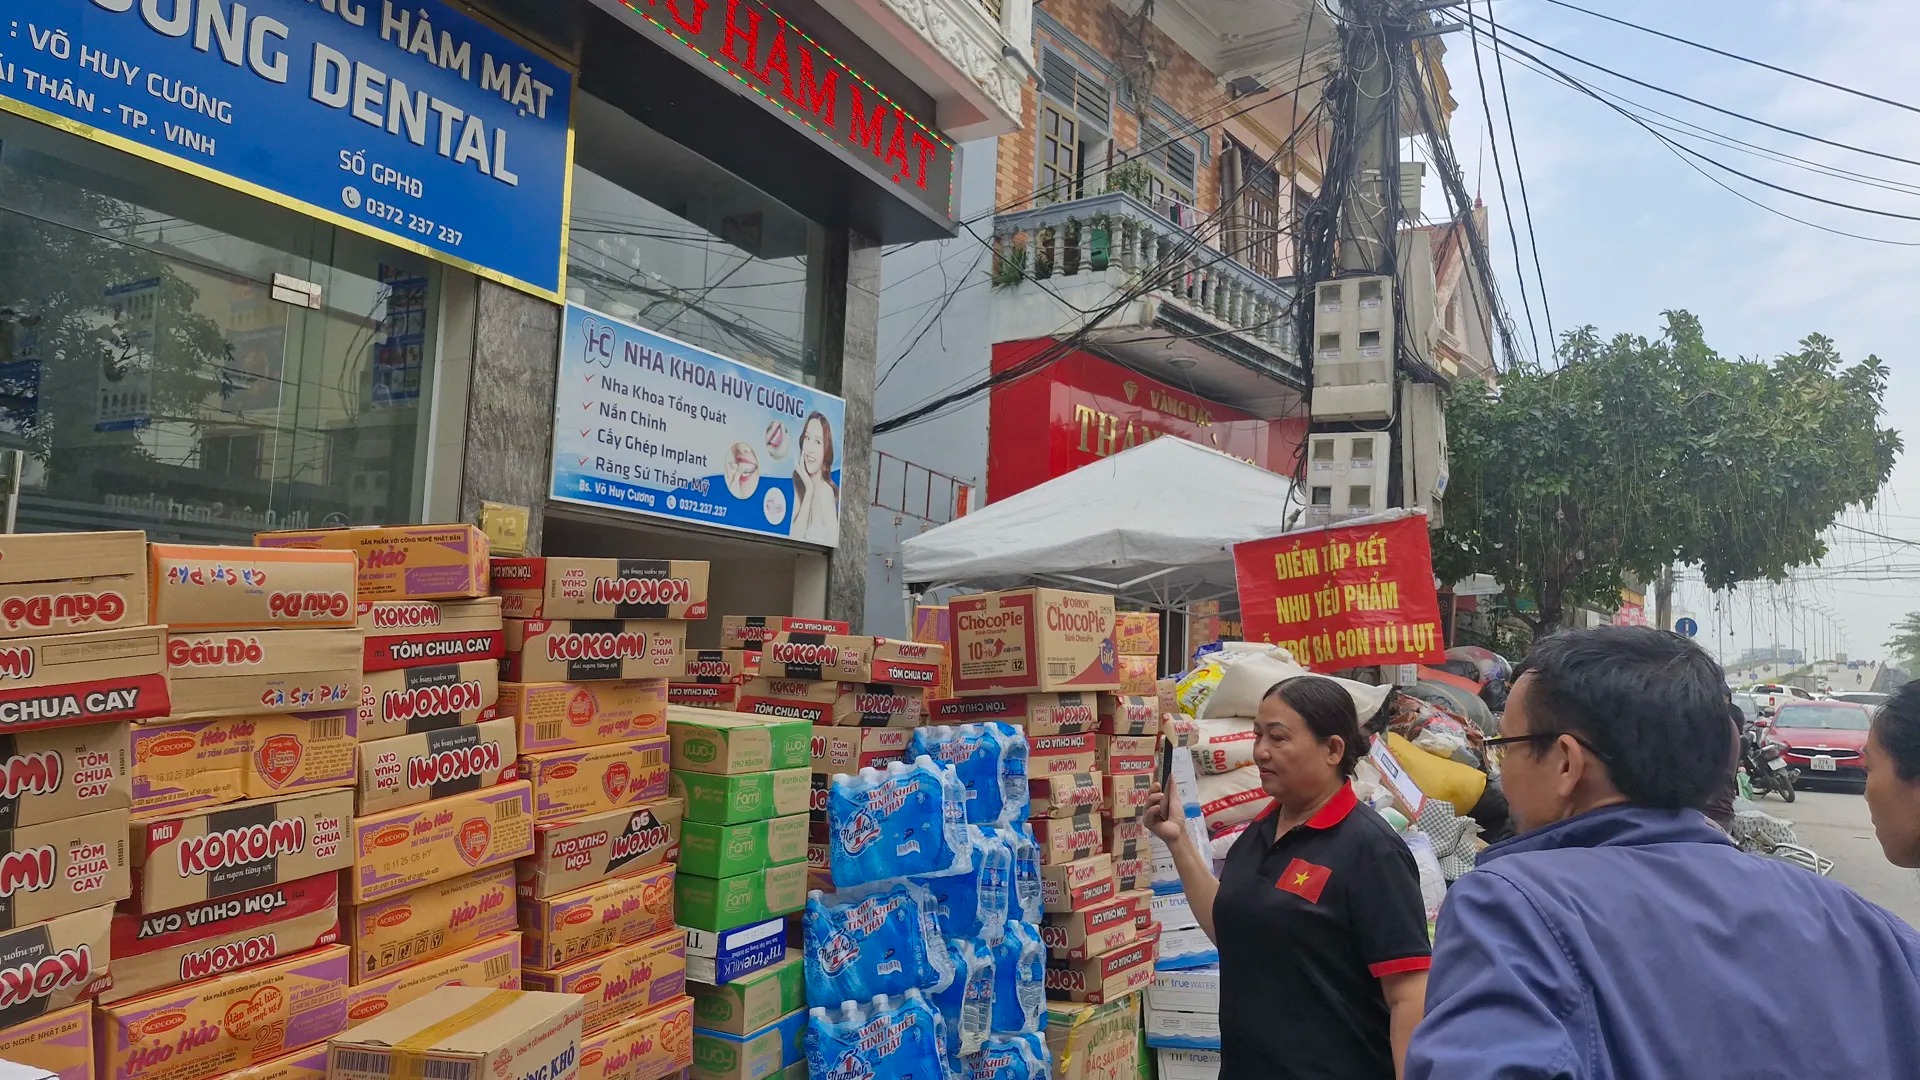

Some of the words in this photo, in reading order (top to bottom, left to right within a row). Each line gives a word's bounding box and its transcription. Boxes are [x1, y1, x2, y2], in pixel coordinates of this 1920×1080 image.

[380, 0, 471, 81] HÀM
[480, 62, 554, 119] MẶT
[720, 0, 840, 130] HÀM
[28, 23, 71, 61] VÕ
[79, 44, 140, 87] HUY
[147, 72, 233, 125] CƯƠNG
[23, 68, 95, 112] THÂN
[163, 121, 216, 157] VINH
[310, 41, 519, 186] DENTAL
[339, 149, 366, 176] SỐ
[371, 163, 423, 199] GPHĐ
[366, 198, 404, 226] 0372
[408, 214, 435, 236] 237
[437, 225, 463, 247] 237
[623, 340, 665, 375] NHA
[669, 357, 717, 392] KHOA
[721, 373, 755, 403] HUY
[756, 383, 805, 419] CƯƠNG
[601, 375, 629, 397] Nha
[632, 386, 665, 407] Khoa
[668, 391, 698, 419] Tổng
[700, 405, 728, 425] Quát
[1150, 389, 1188, 417] VÀNG
[599, 401, 627, 422] Nắn
[630, 408, 668, 433] Chỉnh
[597, 428, 622, 451] Cấy
[625, 434, 658, 459] Ghép
[661, 443, 708, 468] Implant
[595, 456, 630, 480] Răng
[634, 463, 651, 480] Sứ
[654, 468, 689, 489] Thẩm
[689, 479, 711, 497] Mỹ
[578, 478, 592, 494] Bs.
[594, 481, 607, 495] Võ
[608, 484, 626, 502] Huy
[627, 489, 656, 508] Cương
[679, 499, 728, 518] 0372.237.237
[366, 545, 408, 569] Hảo
[1274, 540, 1319, 581] ĐIỂM
[1321, 538, 1351, 576] TẬP
[1356, 531, 1387, 568] KẾT
[560, 578, 588, 588] CHUA
[565, 568, 585, 578] CAY
[563, 589, 585, 599] TÔM
[595, 577, 690, 605] KOKOMI
[1276, 593, 1310, 624] NHU
[1314, 580, 1340, 618] YẾU
[1344, 571, 1399, 612] PHẨM
[2, 596, 55, 628] Đỏ
[54, 592, 126, 625] Gấu
[269, 592, 302, 619] Đỏ
[301, 592, 350, 618] Gấu
[1068, 597, 1090, 609] ORION
[373, 603, 440, 628] KOKOMI
[528, 622, 544, 632] MỚI
[958, 610, 1024, 632] ChocoPie
[1046, 605, 1106, 634] ChocoPie
[168, 637, 224, 667] Gấu
[225, 636, 263, 663] Đỏ
[391, 641, 422, 660] TÔM
[424, 640, 464, 657] CHUA
[466, 636, 493, 651] CAY
[548, 633, 646, 661] KOKOMI
[650, 648, 674, 657] CHUA
[654, 638, 672, 647] TÔM
[967, 641, 984, 661] 10
[1313, 627, 1335, 664] BÀ
[1335, 626, 1372, 658] CON
[1375, 621, 1398, 655] LŨ
[1403, 622, 1436, 660] LỤT
[653, 657, 671, 666] CAY
[771, 643, 839, 667] KOKOMI
[1013, 661, 1023, 670] 12
[687, 661, 732, 677] KOKOMI
[888, 666, 904, 679] TÔM
[904, 669, 921, 681] CHUA
[920, 671, 934, 681] CAY
[260, 687, 285, 707] Gà
[289, 685, 316, 707] Sợi
[319, 682, 350, 704] Phở
[383, 682, 482, 721] KOKOMI
[668, 685, 685, 696] CAY
[684, 685, 703, 696] CHUA
[703, 684, 720, 697] TÔM
[0, 695, 81, 724] CHUA
[86, 688, 138, 713] CAY
[754, 702, 773, 716] TÔM
[773, 704, 800, 719] CHUA
[801, 706, 823, 721] CAY
[854, 692, 908, 715] KOKOMI
[1051, 705, 1093, 726] KOKOMI
[200, 727, 227, 748] Hảo
[228, 720, 256, 740] Hảo
[1035, 739, 1052, 750] CAY
[1052, 737, 1071, 748] CHUA
[1071, 737, 1085, 748] TÔM
[77, 750, 109, 766] TÔM
[378, 752, 397, 765] CAY
[409, 742, 500, 789] KOKOMI
[73, 768, 113, 784] CHUA
[374, 763, 401, 777] CHUA
[78, 783, 108, 798] CAY
[377, 776, 400, 790] TÔM
[868, 796, 892, 812] TINH
[315, 818, 338, 832] TÔM
[631, 811, 650, 831] 90
[152, 824, 173, 842] MỚI
[312, 831, 341, 846] CHUA
[578, 831, 608, 850] CHUA
[610, 824, 672, 861] KOKOMI
[71, 844, 105, 862] TÔM
[179, 817, 305, 878] KOKOMI
[316, 845, 337, 858] CAY
[552, 840, 578, 859] CAY
[66, 860, 109, 878] CHUA
[567, 851, 592, 871] TÔM
[73, 876, 104, 892] CAY
[186, 897, 242, 928] CHUA
[245, 889, 287, 916] TÔM
[137, 914, 181, 940] CAY
[182, 932, 278, 981] KOKOMI
[12, 1032, 36, 1049] NGHỆ
[37, 1026, 60, 1041] NHẬT
[61, 1020, 78, 1035] BẢN
[859, 1032, 885, 1052] TINH
[126, 1038, 174, 1076] Hảo
[176, 1018, 221, 1055] Hảo
